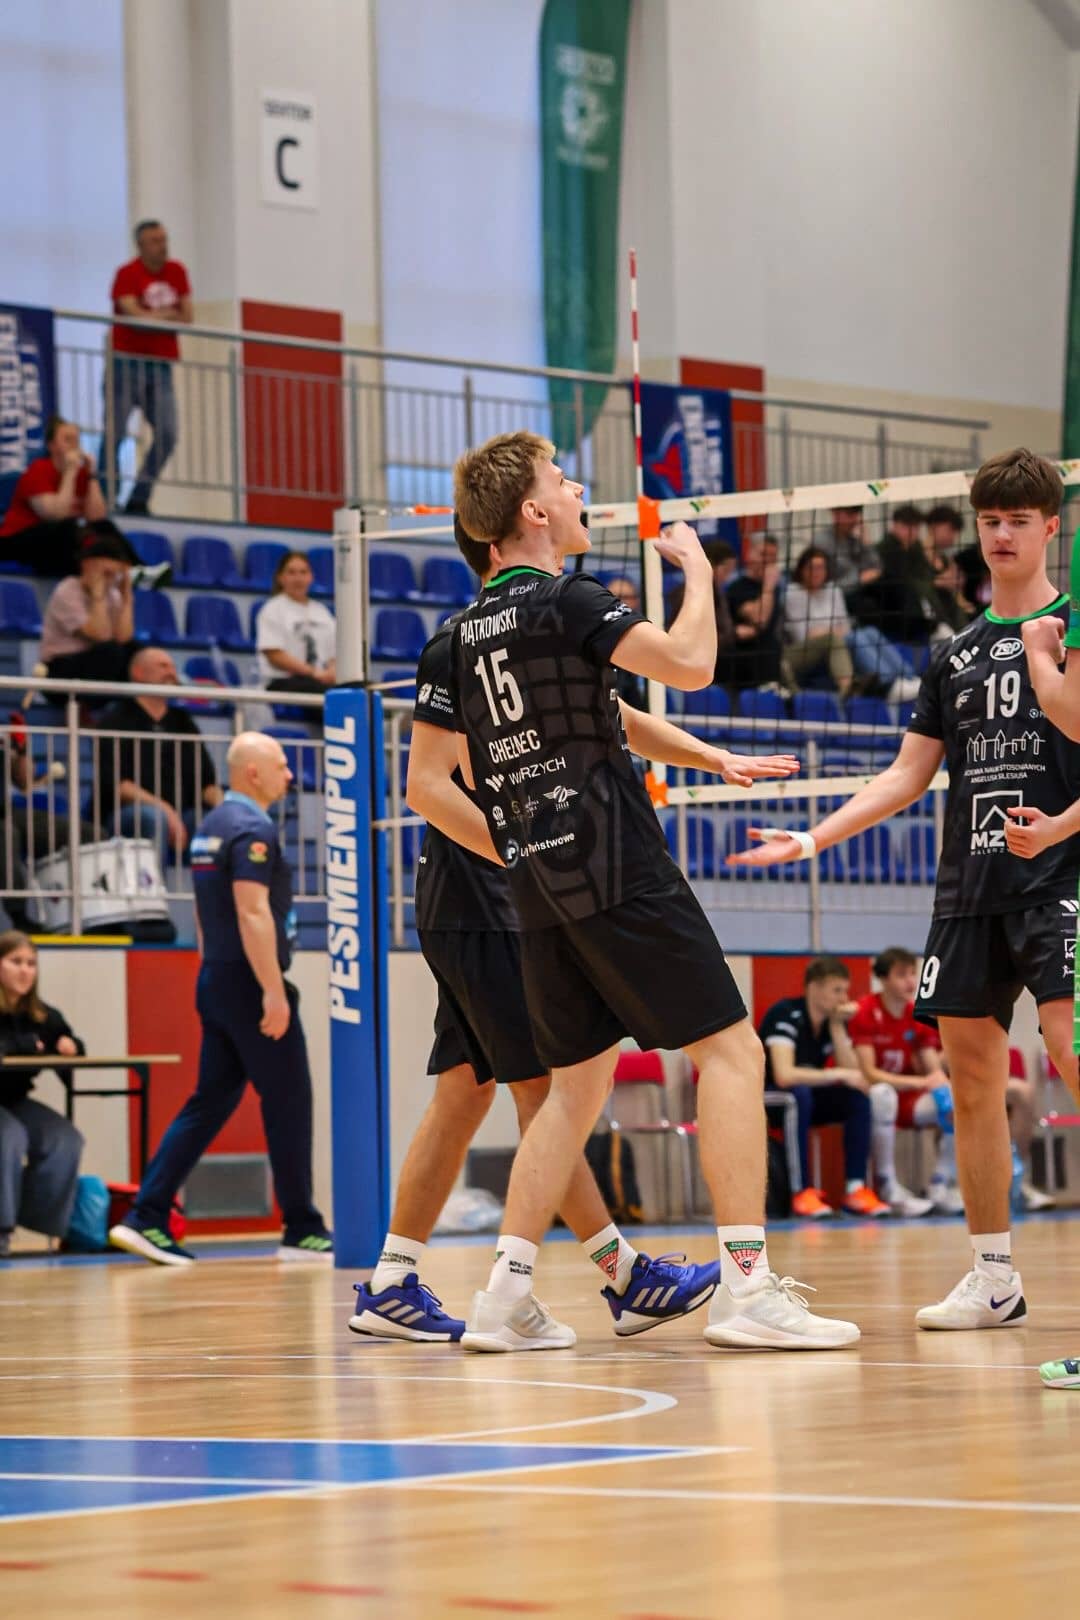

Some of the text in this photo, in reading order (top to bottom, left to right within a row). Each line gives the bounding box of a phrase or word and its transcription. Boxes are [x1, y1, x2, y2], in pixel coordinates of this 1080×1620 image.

[275, 136, 301, 192] C
[460, 606, 517, 647] PIĄTKOWSKI
[474, 648, 524, 727] 15
[983, 670, 1021, 719] 19
[971, 829, 1005, 850] MZ
[323, 716, 361, 1025] PESMENPOL
